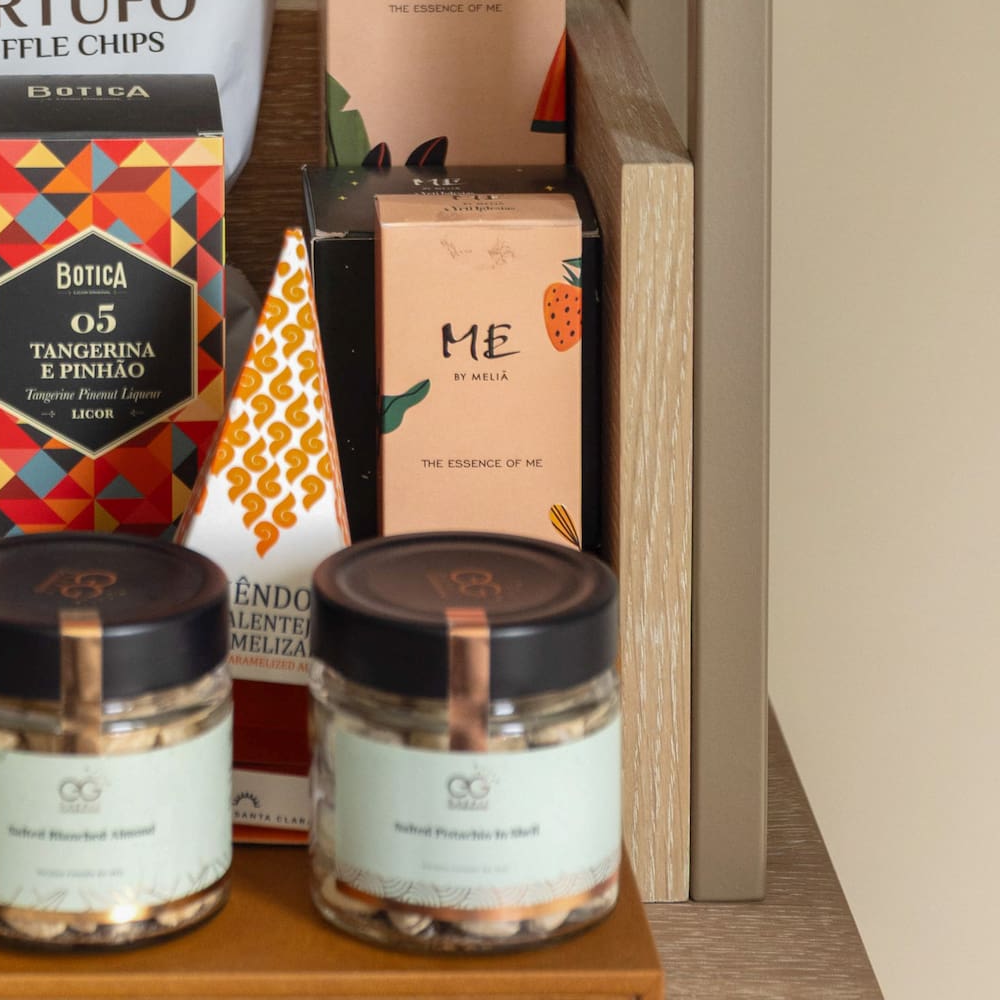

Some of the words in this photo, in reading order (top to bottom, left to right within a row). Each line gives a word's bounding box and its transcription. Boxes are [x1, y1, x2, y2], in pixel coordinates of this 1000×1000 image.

[389, 4, 409, 13] THE
[413, 4, 465, 13] ESSENCE
[467, 4, 483, 13] OF
[486, 3, 503, 12] ME
[78, 31, 165, 56] CHIPS
[56, 261, 128, 290] BOTICA
[441, 322, 521, 361] ME
[30, 342, 156, 360] TANGERINA
[41, 364, 54, 379] E
[60, 359, 145, 380] PINHÃO
[454, 373, 466, 382] BY
[25, 387, 75, 403] Tangerine
[78, 387, 118, 401] Pinenut
[121, 387, 162, 403] Liqueur
[72, 408, 114, 420] LICOR
[421, 459, 443, 468] THE
[448, 459, 502, 468] ESSENCE
[505, 459, 521, 468] OF
[526, 459, 543, 468] ME
